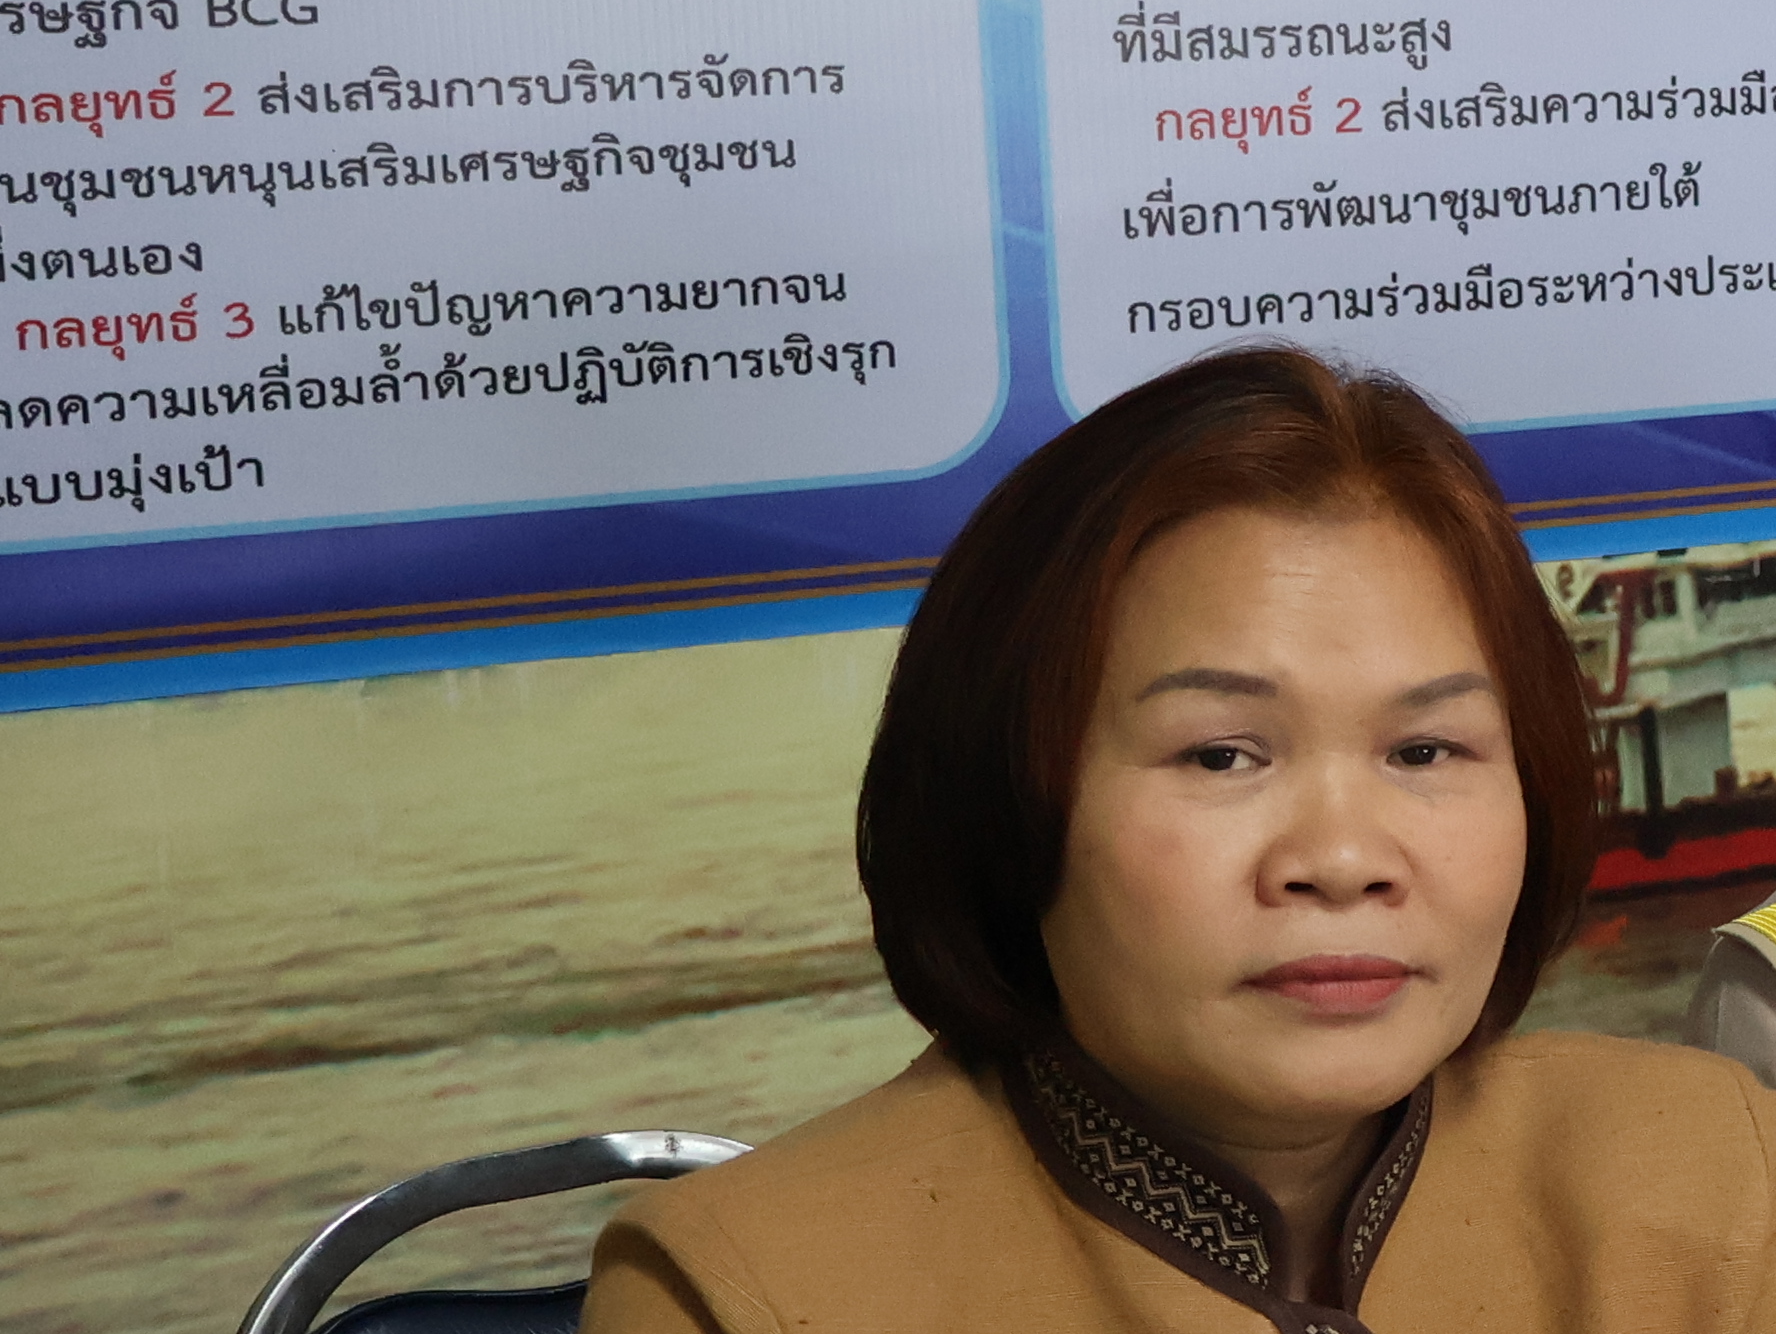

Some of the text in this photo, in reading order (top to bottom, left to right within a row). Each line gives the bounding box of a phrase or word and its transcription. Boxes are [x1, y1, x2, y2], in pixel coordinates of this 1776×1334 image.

[1112, 1, 1452, 72] ที่มีสมรรถนะสูง
[0, 54, 846, 139] กลยุทธ์ 2 ส่งเสริมการบริหารจัดการ
[1155, 86, 1315, 155] กลยุทธ์
[1334, 96, 1363, 136] 2
[1122, 160, 1702, 244] เพื่อการพัฒนาชุมชนภายใต้
[0, 236, 205, 286] งตนเอง
[16, 267, 848, 361] กลยุทธ์ 3 แก้ไขปัญหาความยากจน
[0, 448, 266, 516] แบบมุ่งเป้า
